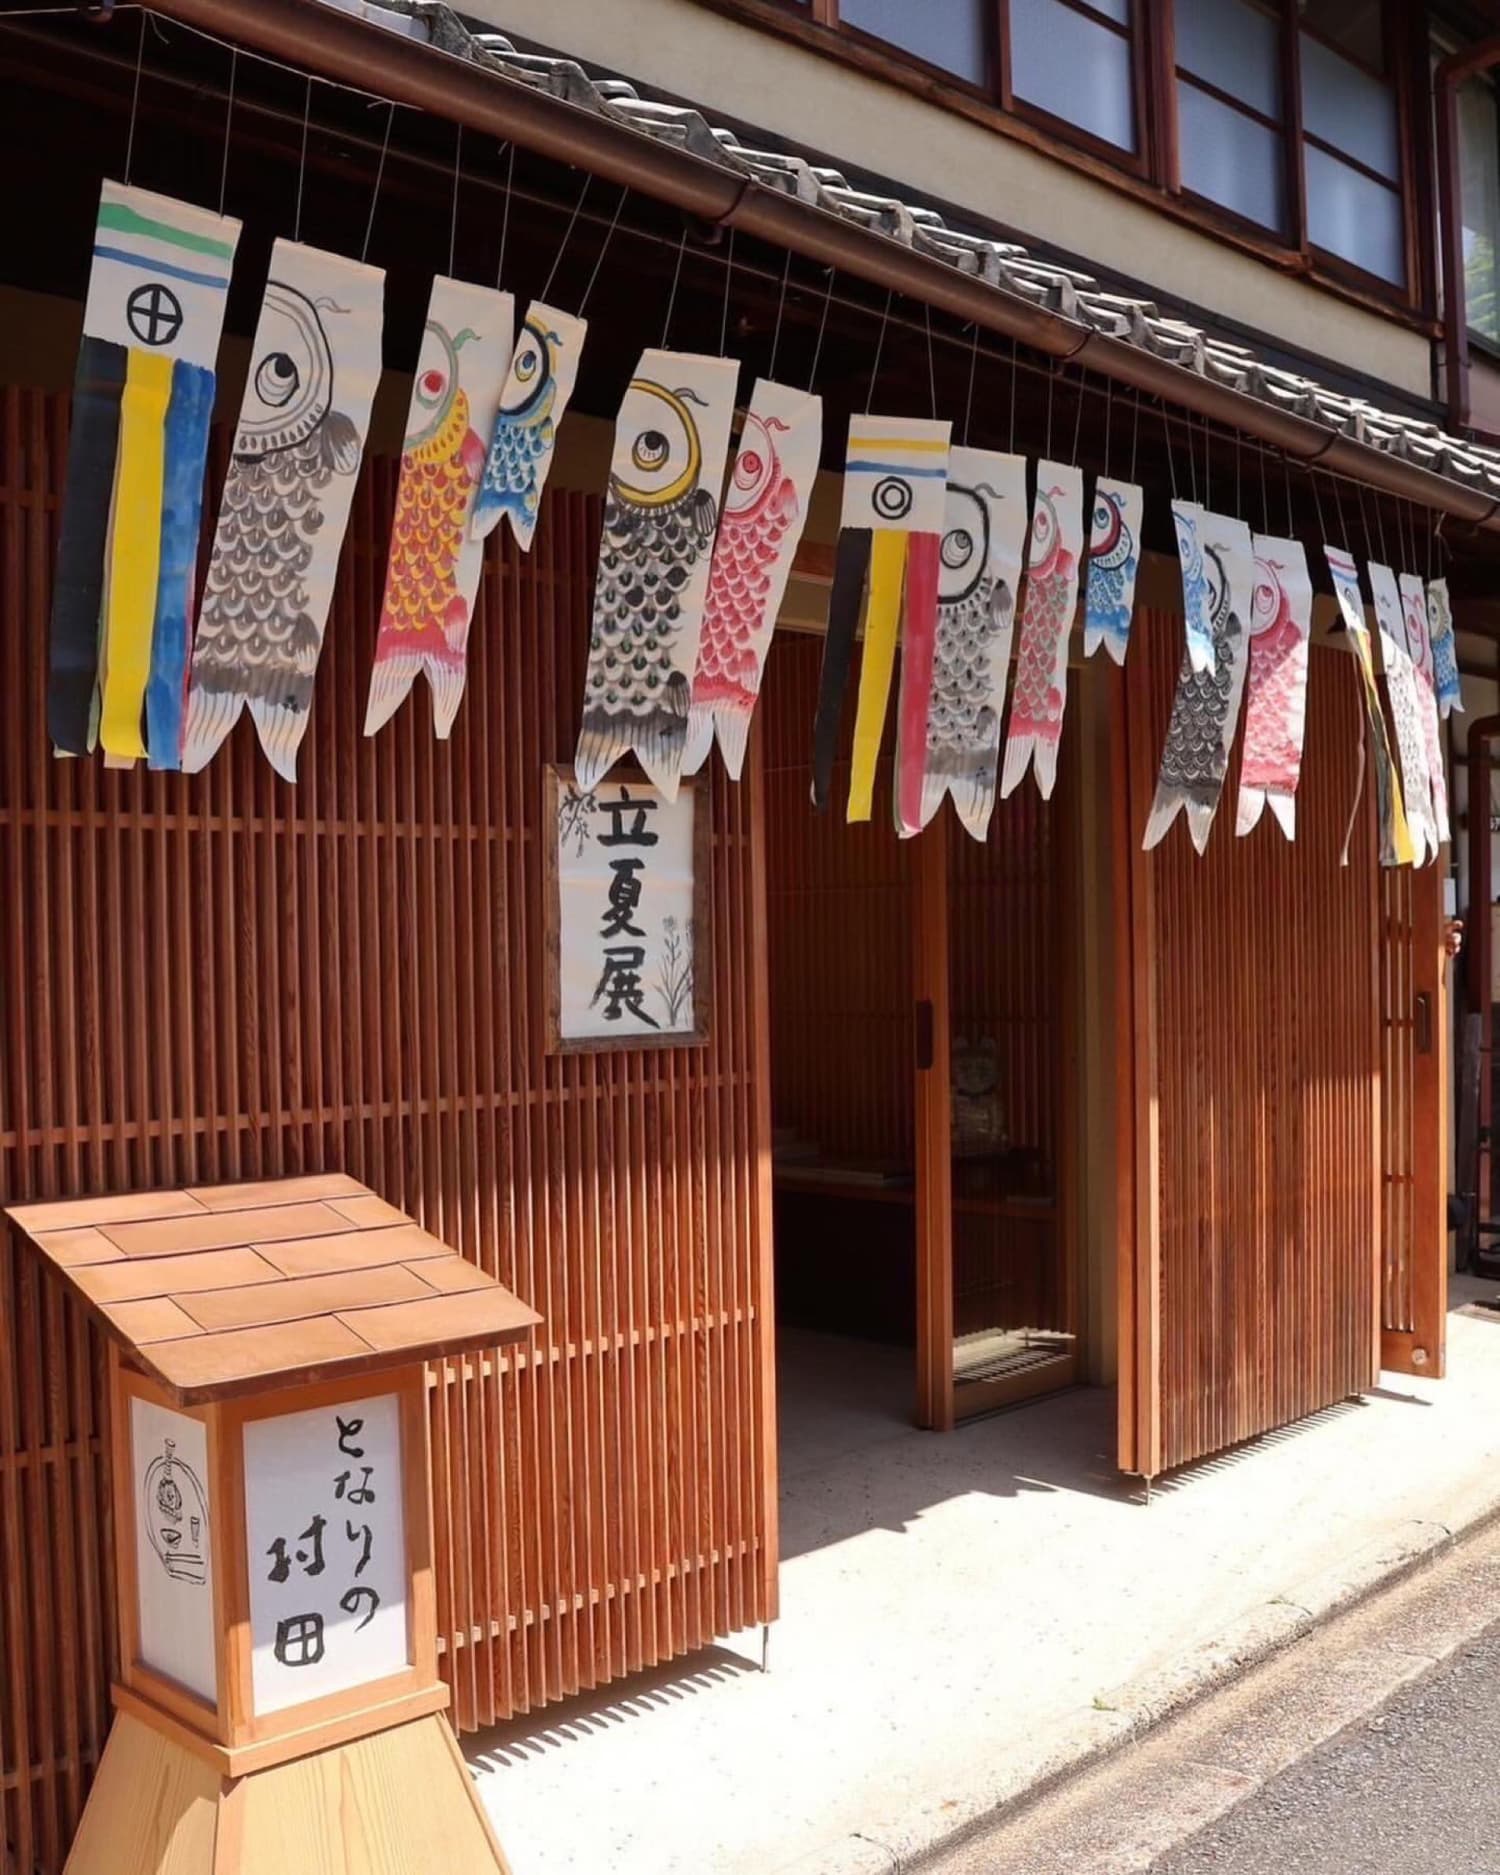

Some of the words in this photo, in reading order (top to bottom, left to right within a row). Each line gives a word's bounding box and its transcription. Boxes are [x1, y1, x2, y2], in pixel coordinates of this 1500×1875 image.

[588, 785, 660, 1029] 立夏展
[266, 1514, 327, 1667] 村田
[333, 1415, 380, 1632] となりの
